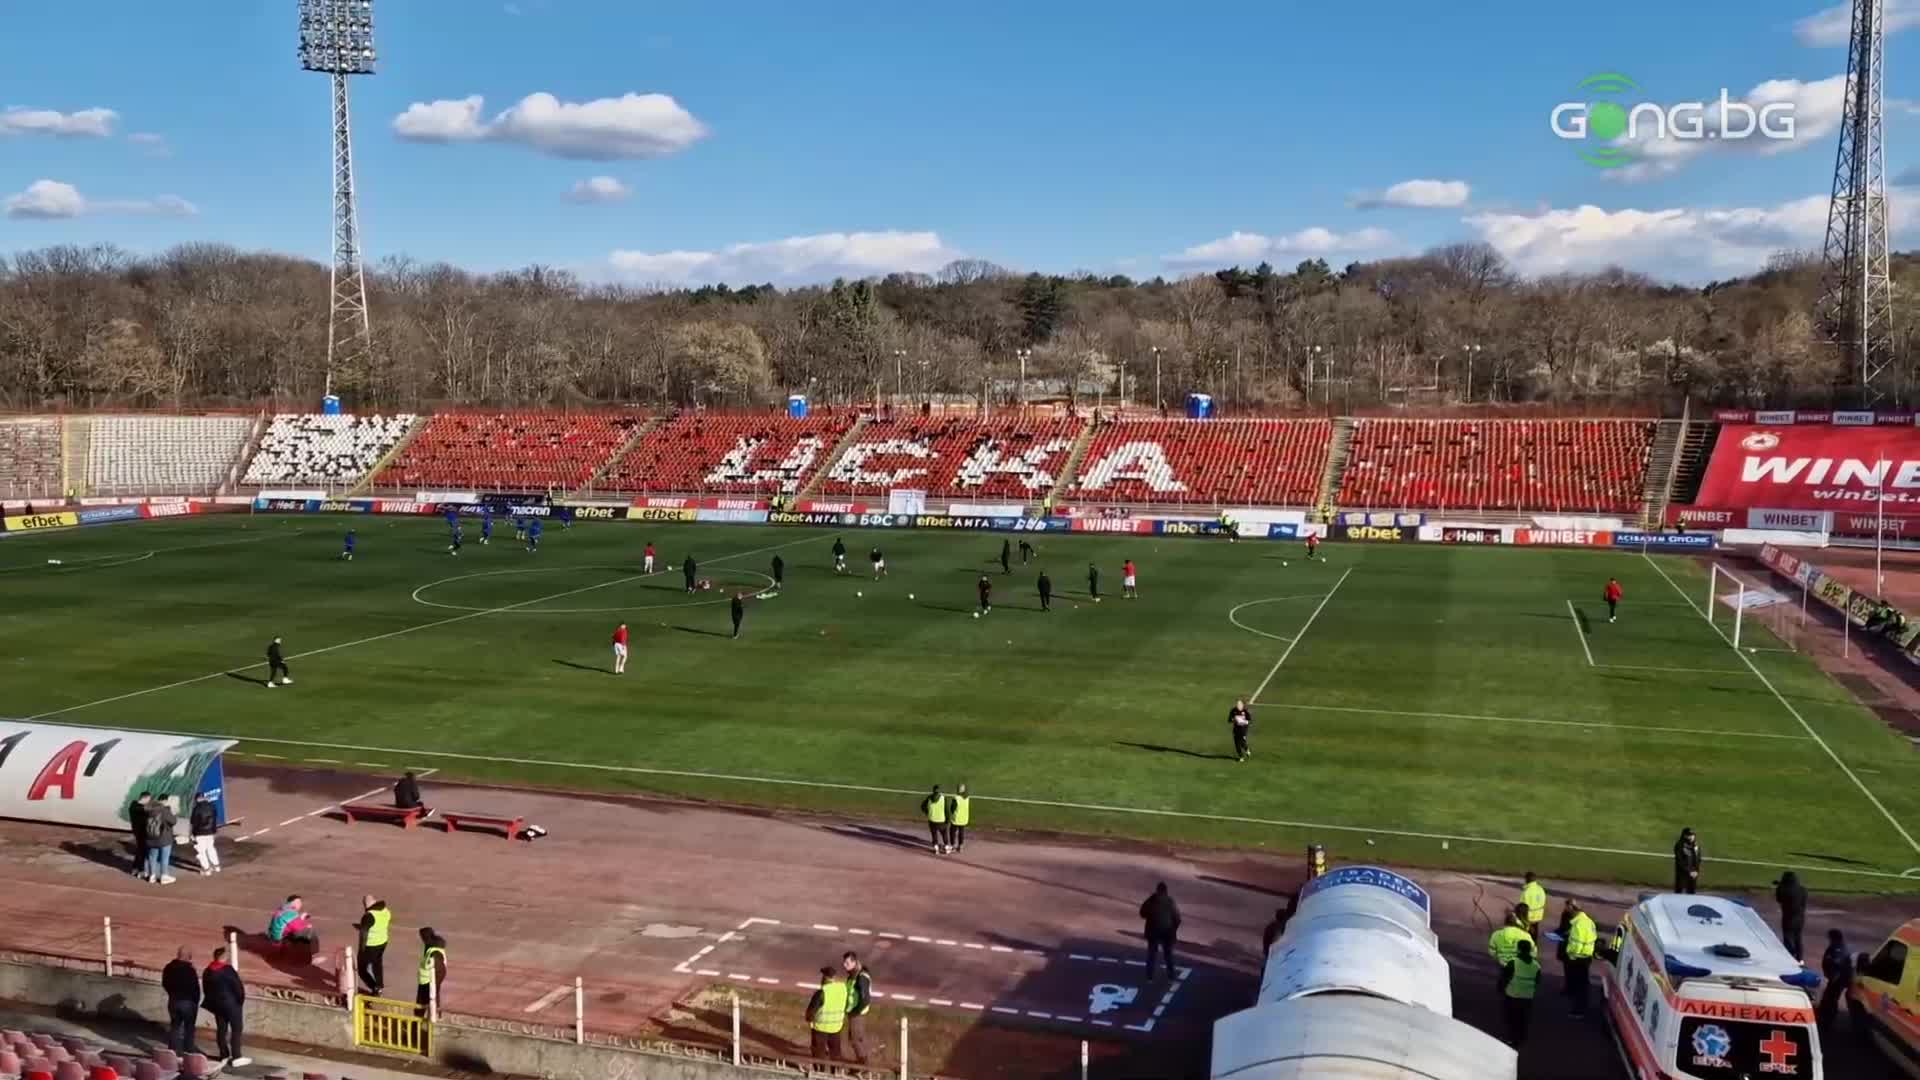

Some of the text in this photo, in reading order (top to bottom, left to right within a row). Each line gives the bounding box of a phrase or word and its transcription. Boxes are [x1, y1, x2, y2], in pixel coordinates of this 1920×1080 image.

[1718, 413, 1749, 421] WINBET
[1759, 414, 1791, 422] WINBET
[1798, 414, 1829, 422] WINBET
[1837, 415, 1869, 423] WINBET
[1877, 415, 1911, 423] WINBET
[703, 436, 1188, 493] ЦСКА
[1813, 488, 1920, 503] winbet.
[148, 502, 191, 517] WINBET
[381, 502, 425, 513] WINBET
[648, 498, 687, 508] WINBET
[717, 500, 758, 510] WINBET
[812, 502, 853, 513] WINBET
[575, 507, 614, 518] efbet
[642, 507, 682, 520] efbet
[1680, 510, 1734, 523] WINBET
[22, 514, 63, 528] efbet
[860, 513, 893, 527] БФС
[1083, 518, 1141, 532] WINBET
[1763, 512, 1818, 527] WINBET
[1850, 516, 1907, 531] WINBET
[1347, 526, 1401, 540] efbet
[1456, 529, 1500, 543] Helios
[1529, 530, 1596, 544] WINBET
[27, 738, 122, 801] A1
